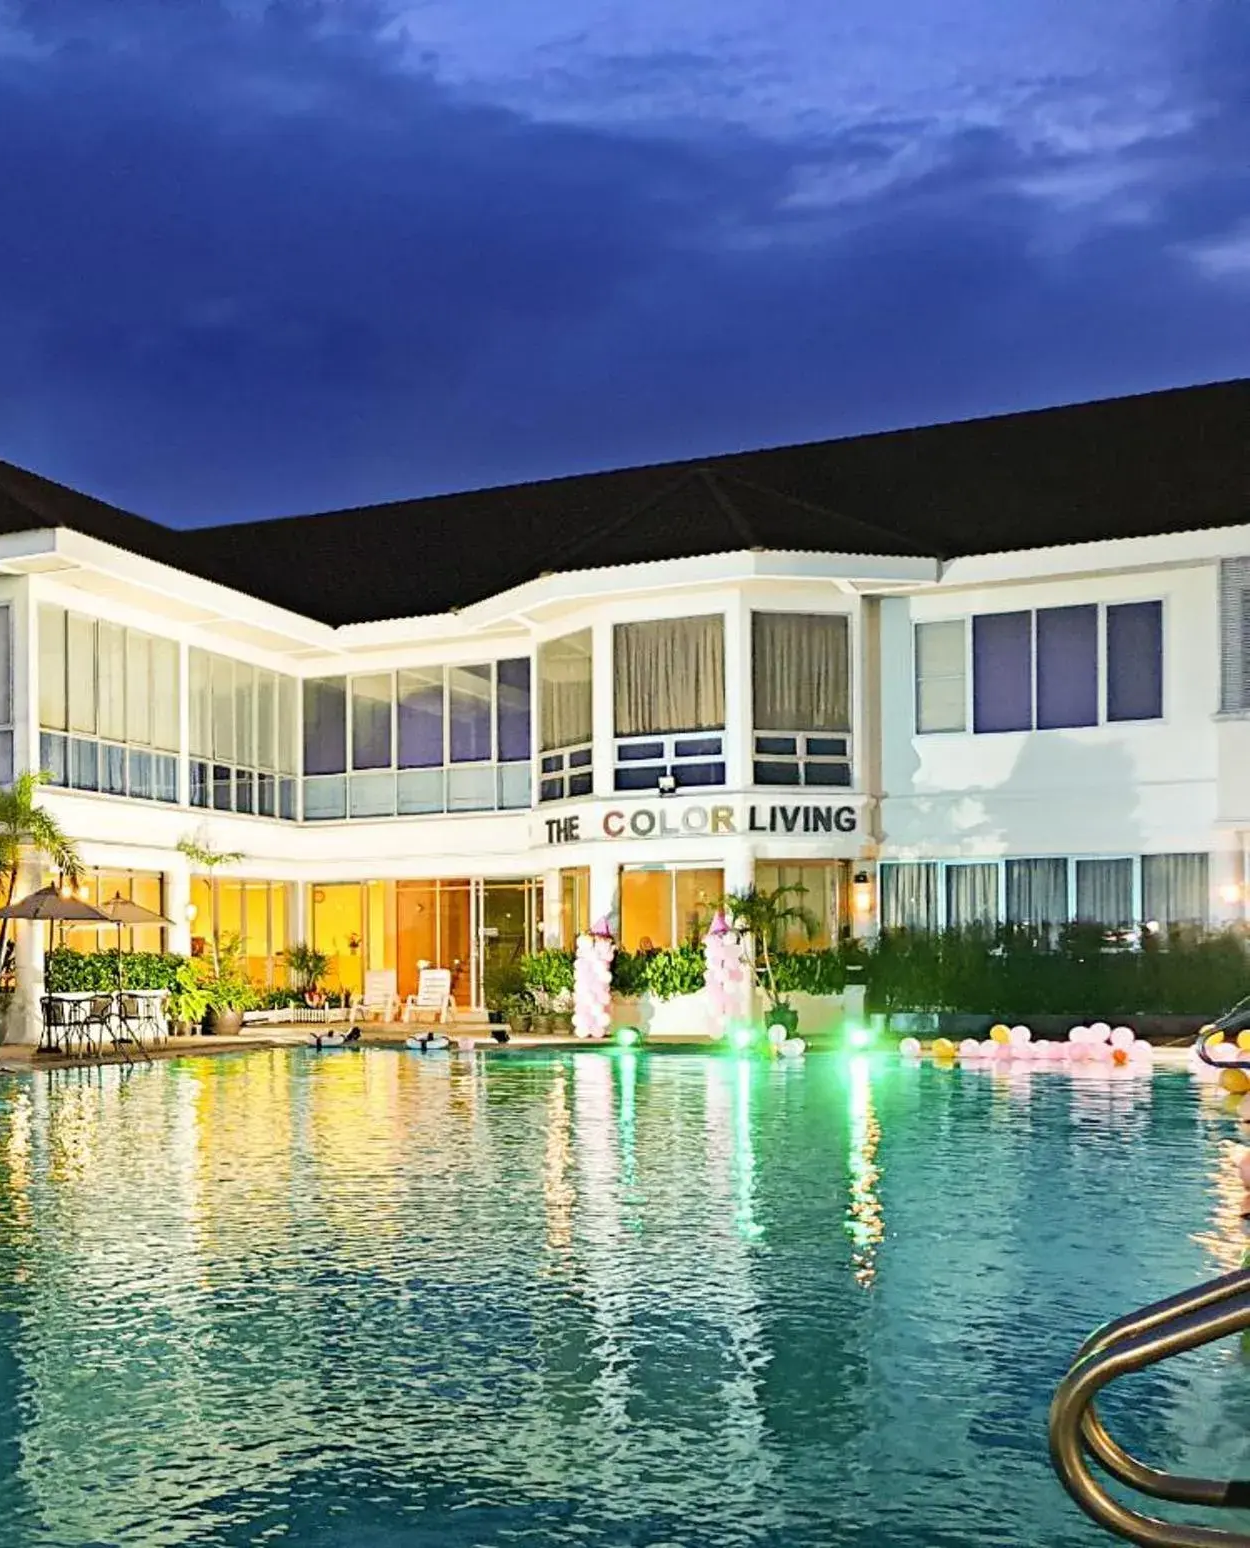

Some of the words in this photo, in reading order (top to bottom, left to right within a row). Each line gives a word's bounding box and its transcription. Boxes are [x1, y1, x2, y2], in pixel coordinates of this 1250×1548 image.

[545, 816, 580, 844] THE
[602, 806, 736, 837] COLOR
[749, 805, 857, 833] LIVING
